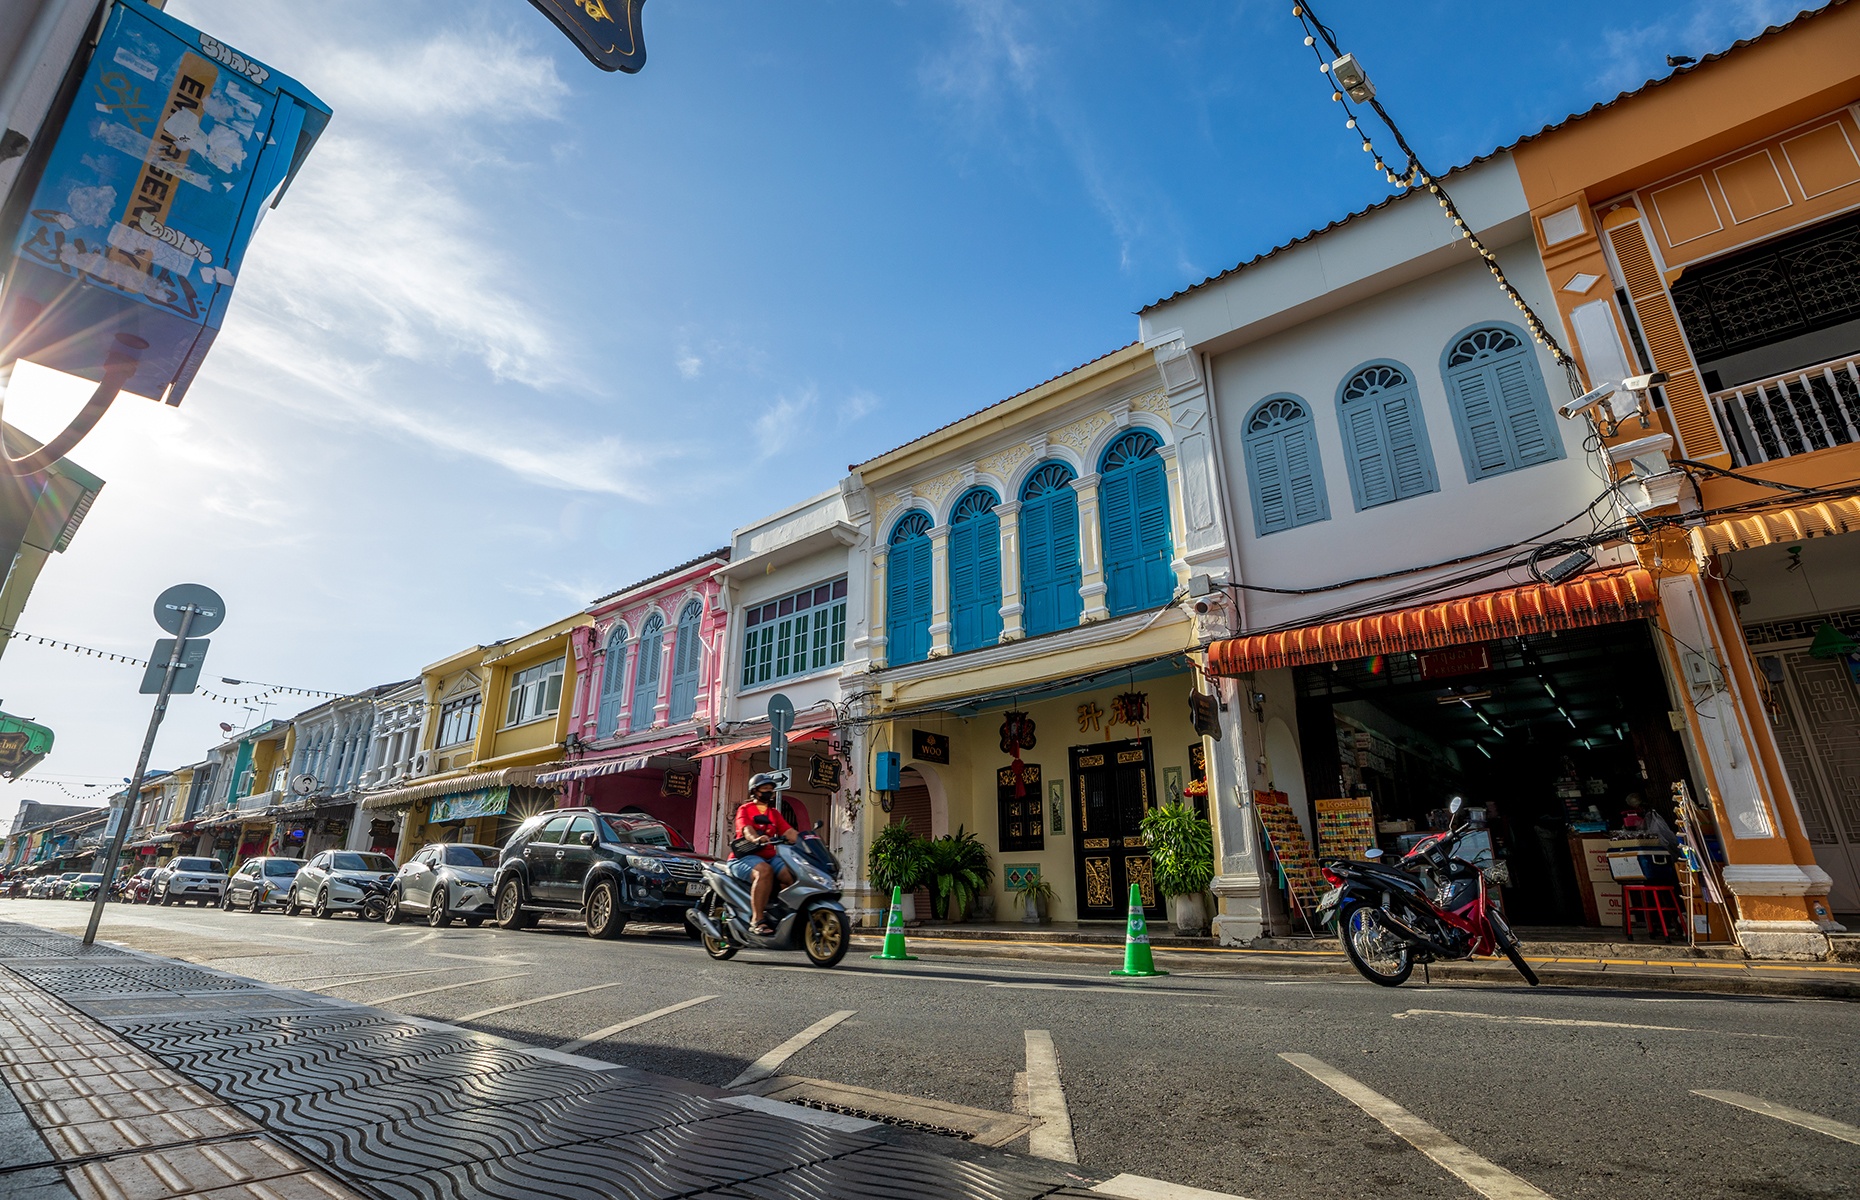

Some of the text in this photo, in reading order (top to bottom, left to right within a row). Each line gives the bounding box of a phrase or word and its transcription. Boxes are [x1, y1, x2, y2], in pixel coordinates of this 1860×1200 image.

[1434, 662, 1477, 675] KRISHNA
[921, 745, 942, 757] WOO
[1609, 899, 1621, 907] OIL
